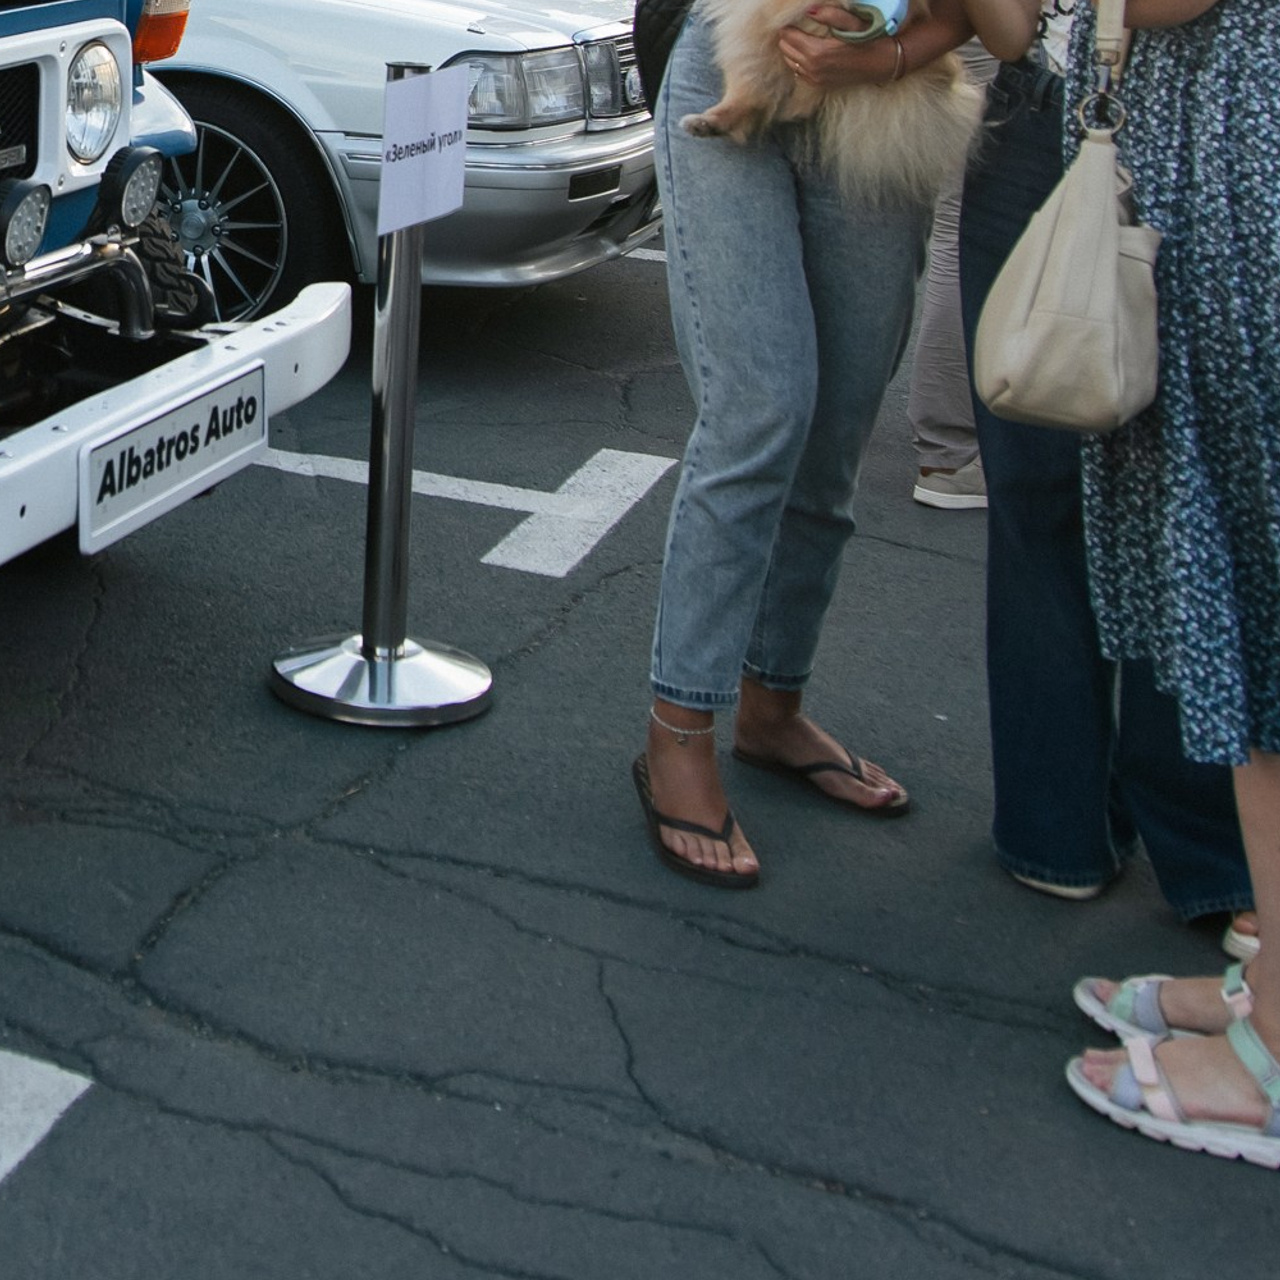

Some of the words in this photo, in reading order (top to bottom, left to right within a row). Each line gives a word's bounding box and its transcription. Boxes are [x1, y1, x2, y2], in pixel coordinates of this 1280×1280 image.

[385, 131, 436, 163] «Зеленый
[96, 423, 200, 505] Albatros
[204, 395, 257, 448] Auto
